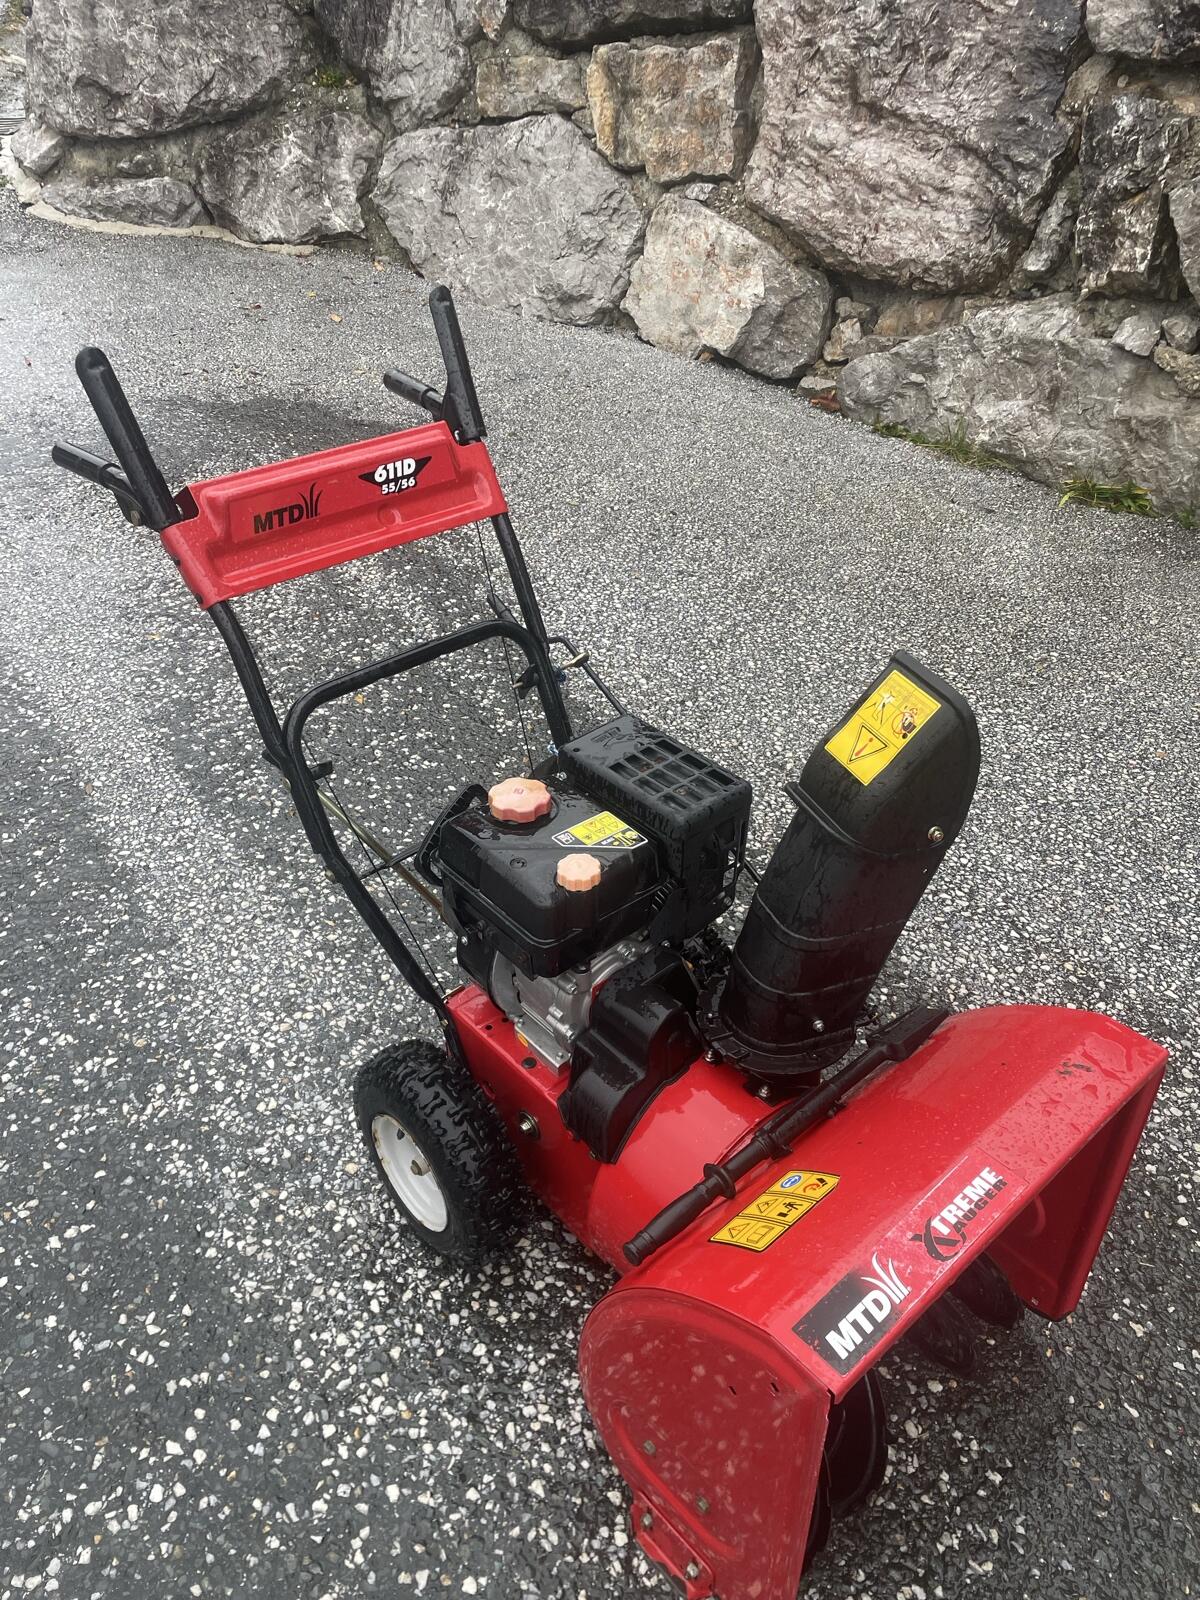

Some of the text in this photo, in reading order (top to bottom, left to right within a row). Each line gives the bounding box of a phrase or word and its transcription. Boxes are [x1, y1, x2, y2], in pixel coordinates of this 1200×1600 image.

[374, 457, 416, 483] 611D
[381, 476, 416, 495] 55/56
[254, 503, 305, 535] MTD
[954, 1178, 1008, 1234] AUGER
[825, 1289, 892, 1361] MTD
